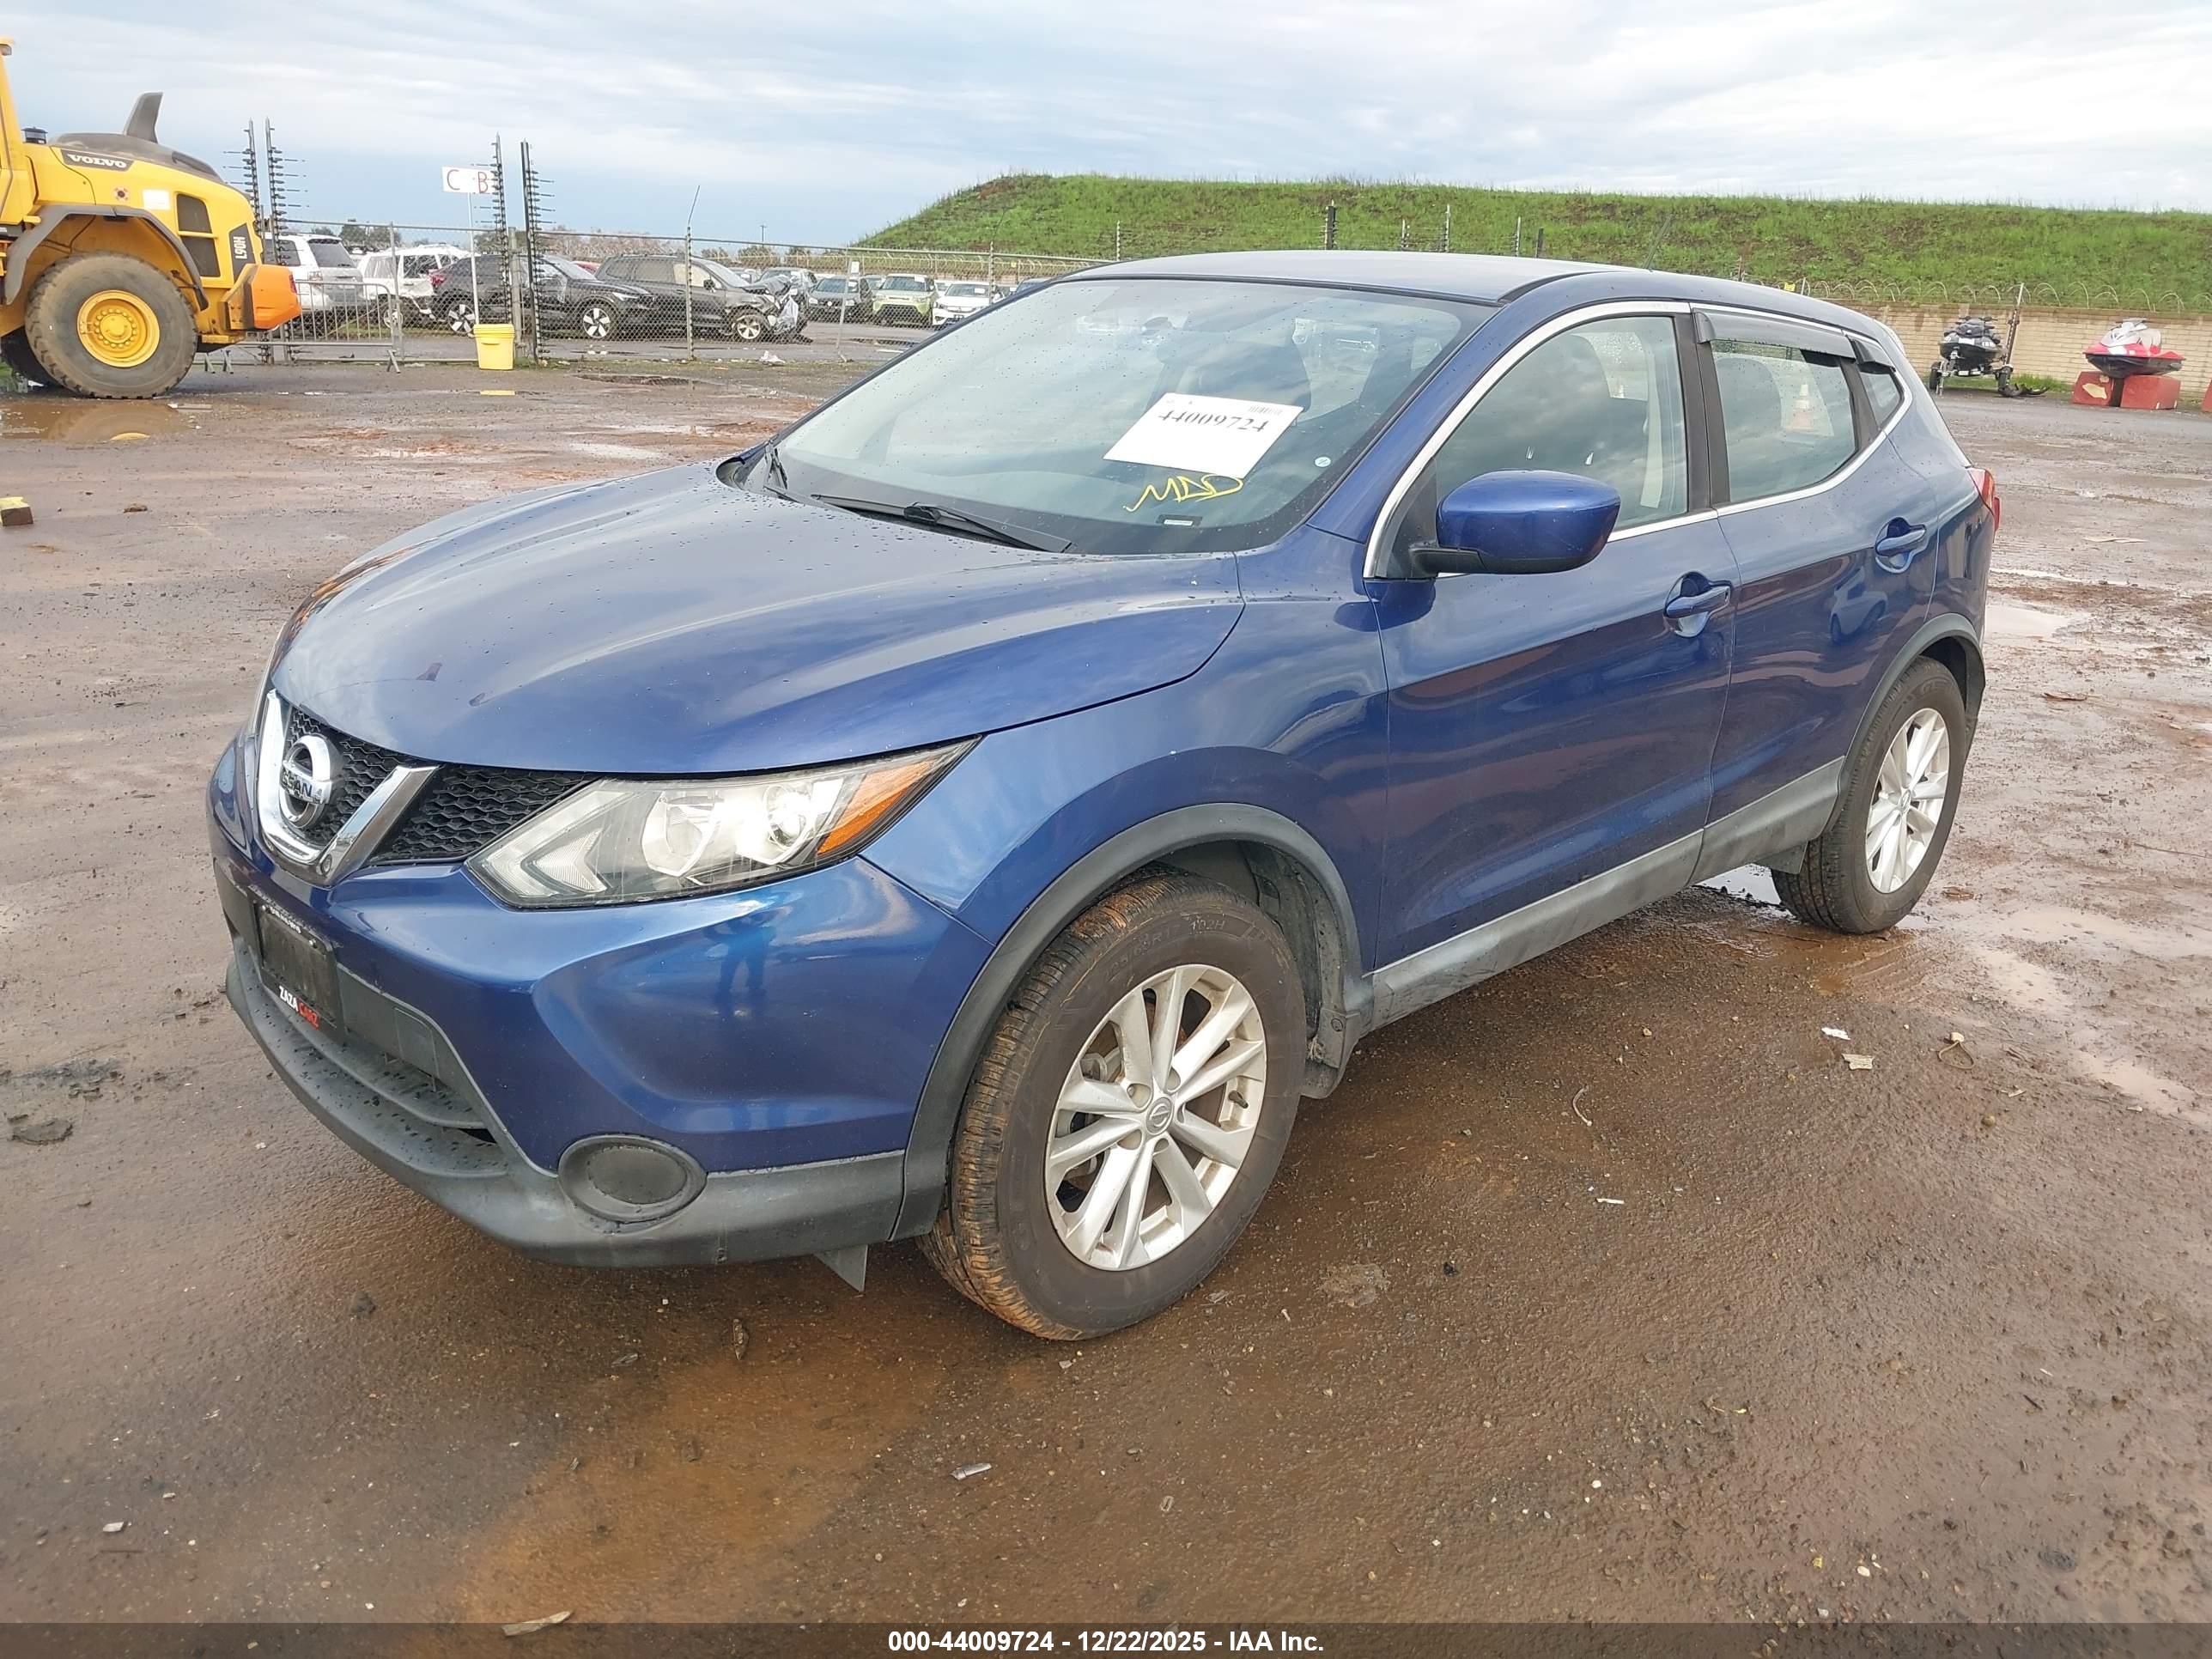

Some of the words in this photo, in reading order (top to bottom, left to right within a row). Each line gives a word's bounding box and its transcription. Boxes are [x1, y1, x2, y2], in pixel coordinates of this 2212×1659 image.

[66, 153, 128, 169] VOLVO
[447, 169, 461, 191] C
[477, 171, 489, 194] B
[233, 235, 248, 259] L90H
[1157, 409, 1270, 433] 44009724
[278, 985, 299, 1012] ZAZA
